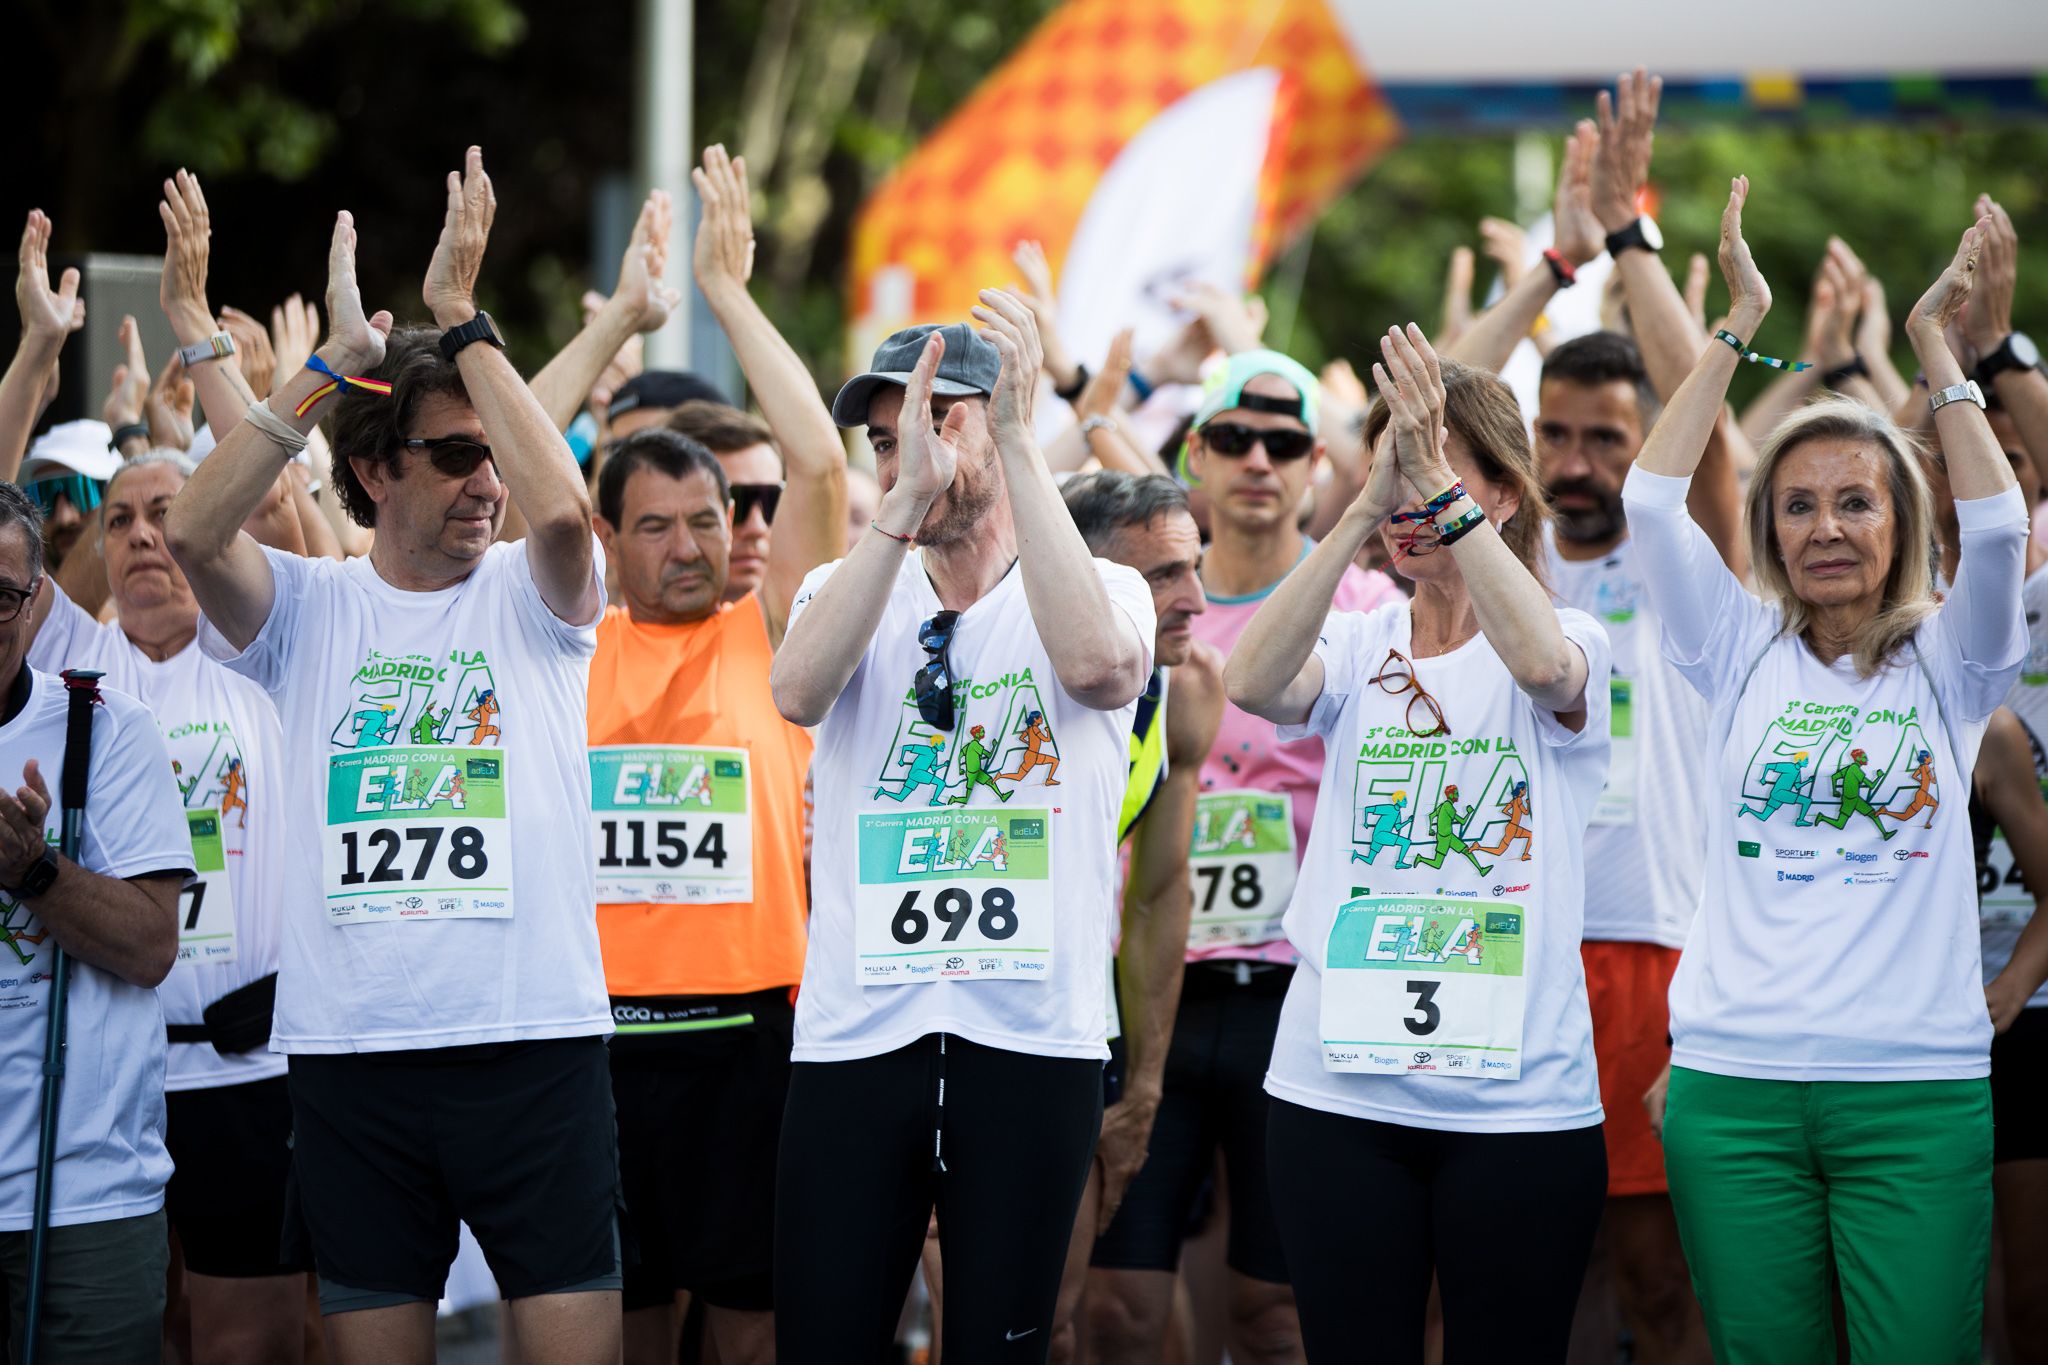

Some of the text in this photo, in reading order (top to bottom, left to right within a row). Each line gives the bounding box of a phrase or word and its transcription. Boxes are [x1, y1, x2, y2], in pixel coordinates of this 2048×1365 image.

[358, 663, 434, 680] MADRID
[461, 651, 486, 665] LA
[1012, 667, 1033, 687] LA
[1803, 702, 1859, 717] Carrera
[168, 722, 208, 740] CON
[1777, 716, 1853, 736] MADRID
[1359, 736, 1517, 758] MADRID CON LA
[364, 754, 408, 766] MADRID
[411, 753, 438, 763] CON
[441, 753, 456, 763] LA
[355, 764, 466, 814] ELA
[613, 762, 713, 806] ELA
[874, 819, 904, 828] Carrera
[906, 815, 951, 827] MADRID
[954, 815, 980, 825] CON
[983, 815, 998, 825] LA
[1014, 828, 1039, 836] adELA
[599, 820, 728, 869] 1154
[897, 826, 1008, 875] ELA
[341, 826, 488, 886] 1278
[1845, 852, 1878, 863] Biogen
[1190, 863, 1263, 913] 78
[1785, 874, 1815, 882] MADRID
[480, 901, 505, 909] MADRID
[1378, 904, 1426, 915] MADRID
[1429, 905, 1456, 916] CON
[1459, 906, 1475, 916] LA
[891, 887, 1019, 945] 698
[1364, 915, 1482, 966] ELA
[1020, 963, 1045, 971] MADRID
[1403, 980, 1442, 1036] 3
[1374, 1056, 1399, 1066] Biogen
[1487, 1062, 1512, 1070] MADRID
